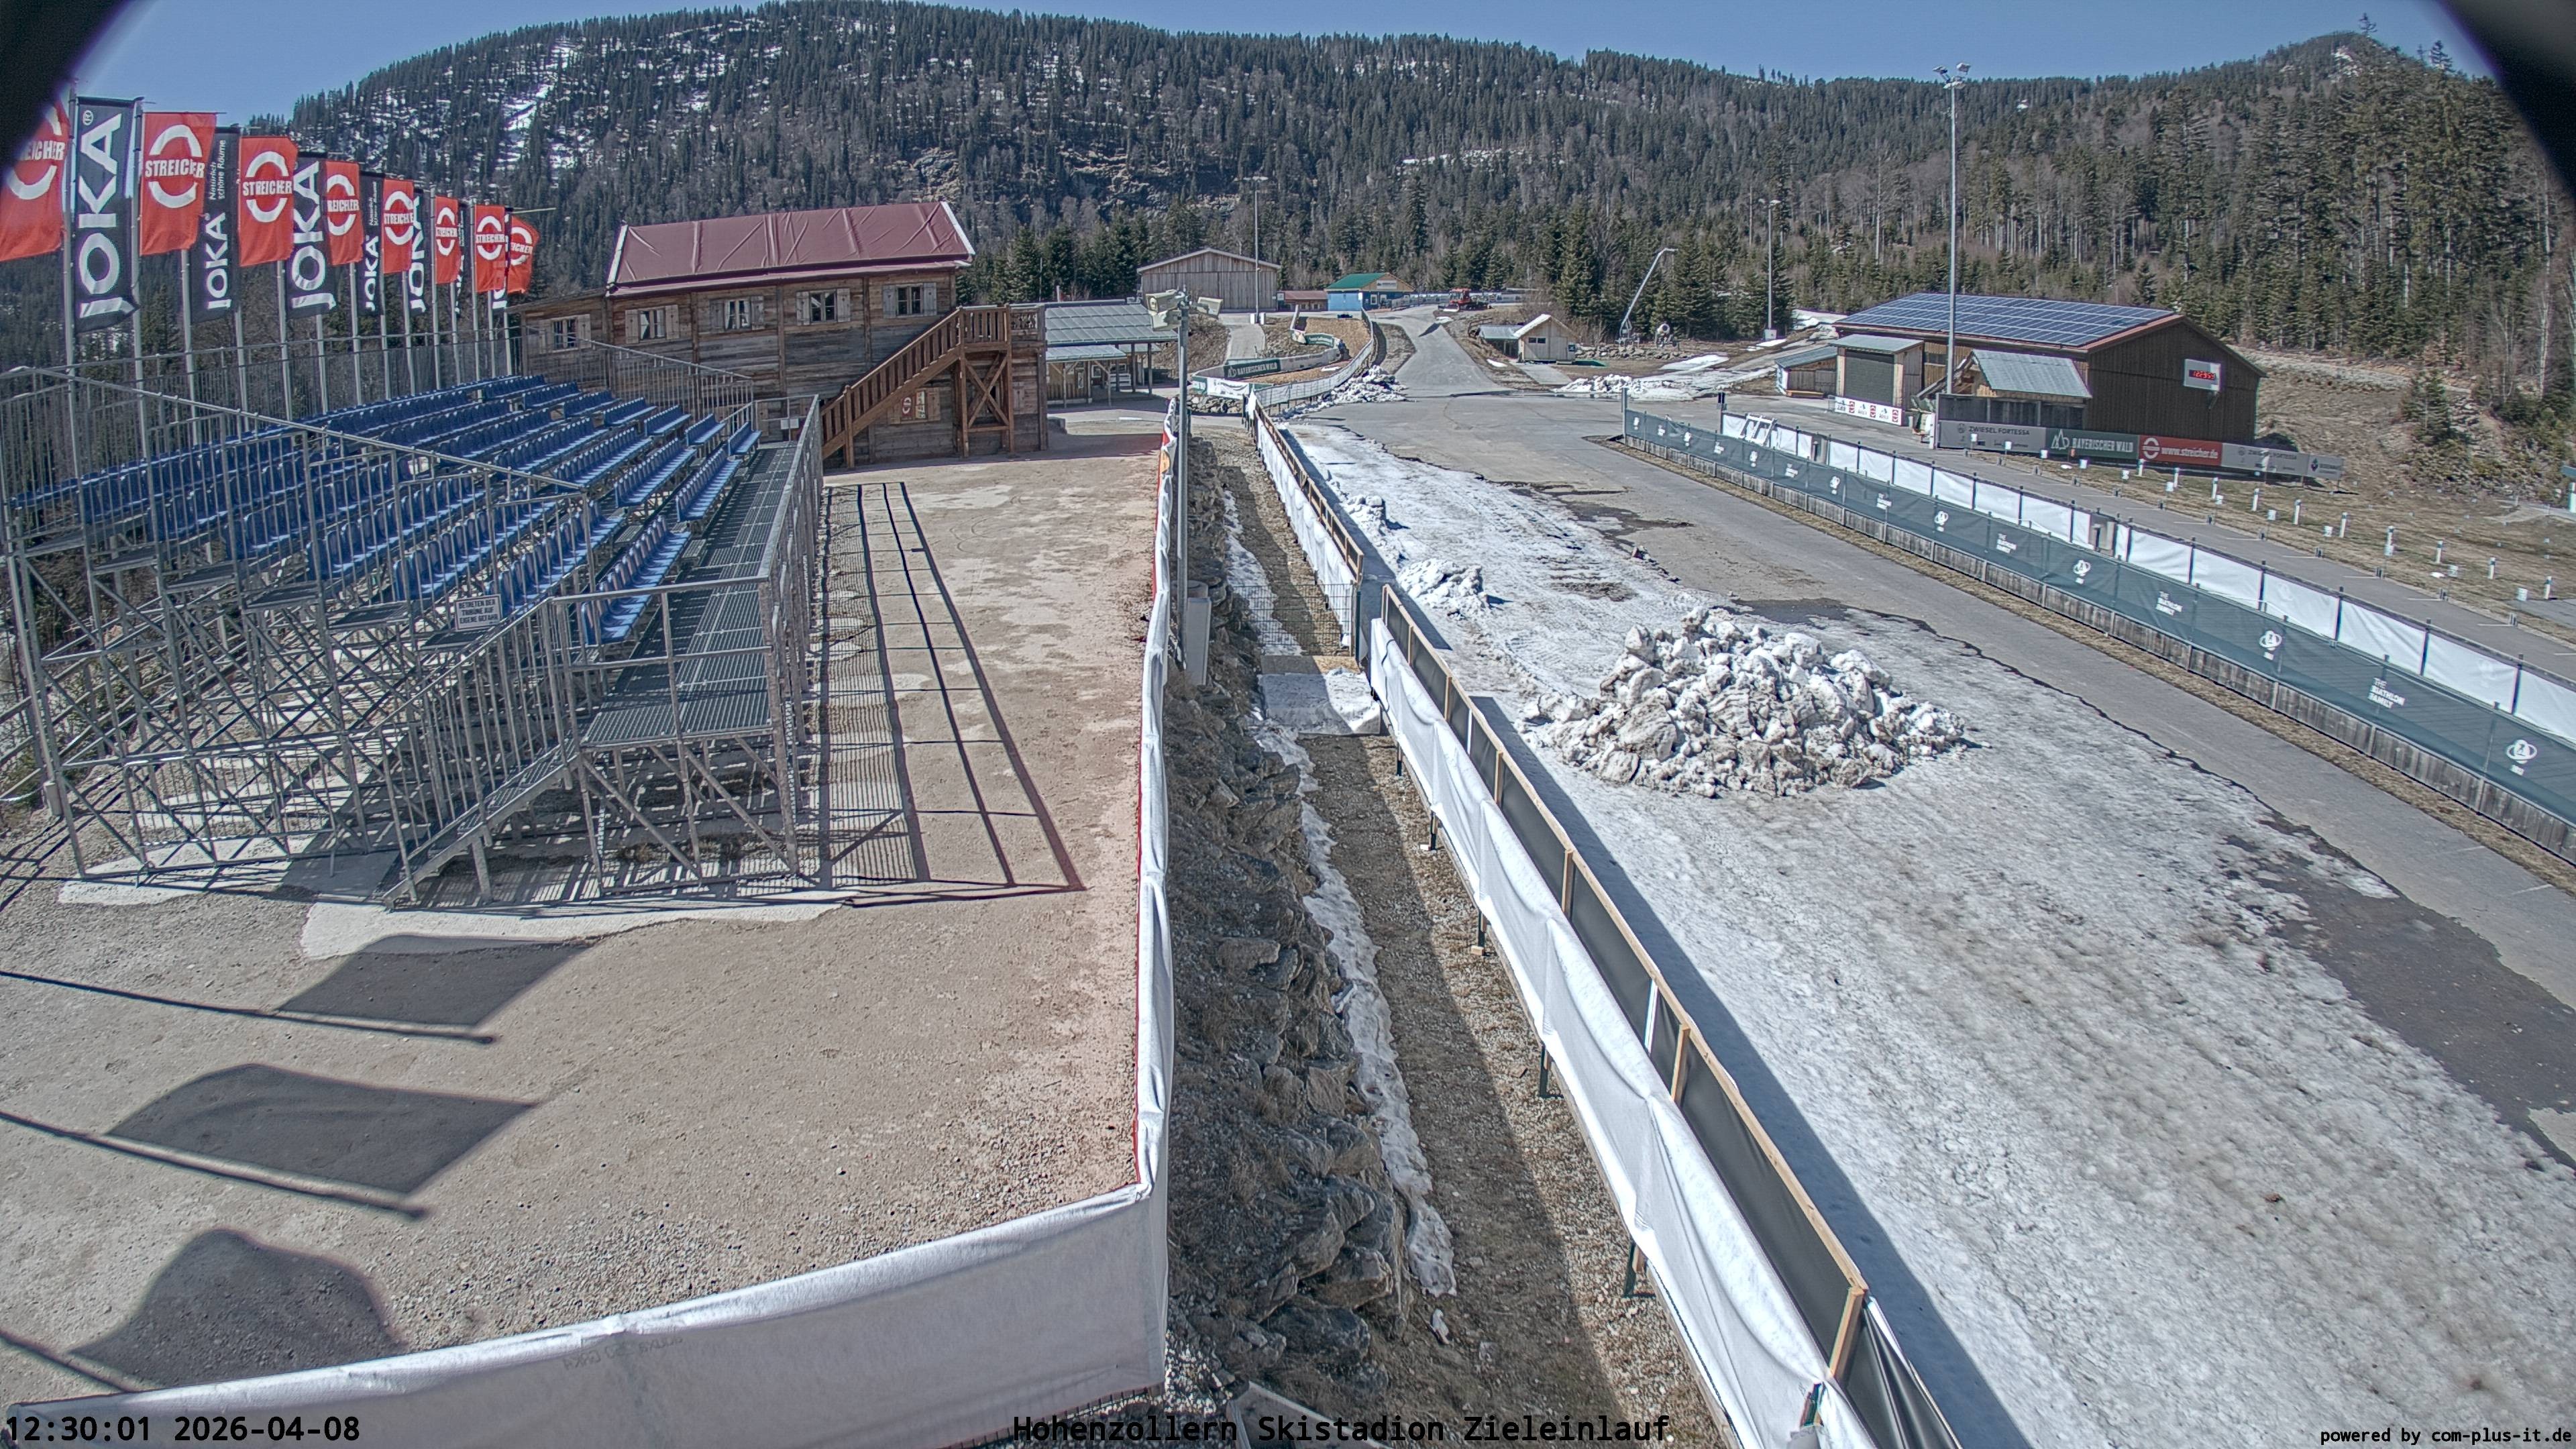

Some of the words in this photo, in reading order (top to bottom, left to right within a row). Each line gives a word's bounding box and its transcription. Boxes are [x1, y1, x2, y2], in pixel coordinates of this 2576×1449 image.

[78, 113, 139, 319] JOKA
[291, 161, 337, 310] JOKA
[205, 212, 232, 310] JOKA
[364, 235, 379, 311] JOKA
[1968, 426, 1998, 434] ZWIESEL
[2072, 437, 2115, 451] BAYERISCHER
[2116, 441, 2133, 453] WALD
[2161, 447, 2218, 459] www.streicher.de
